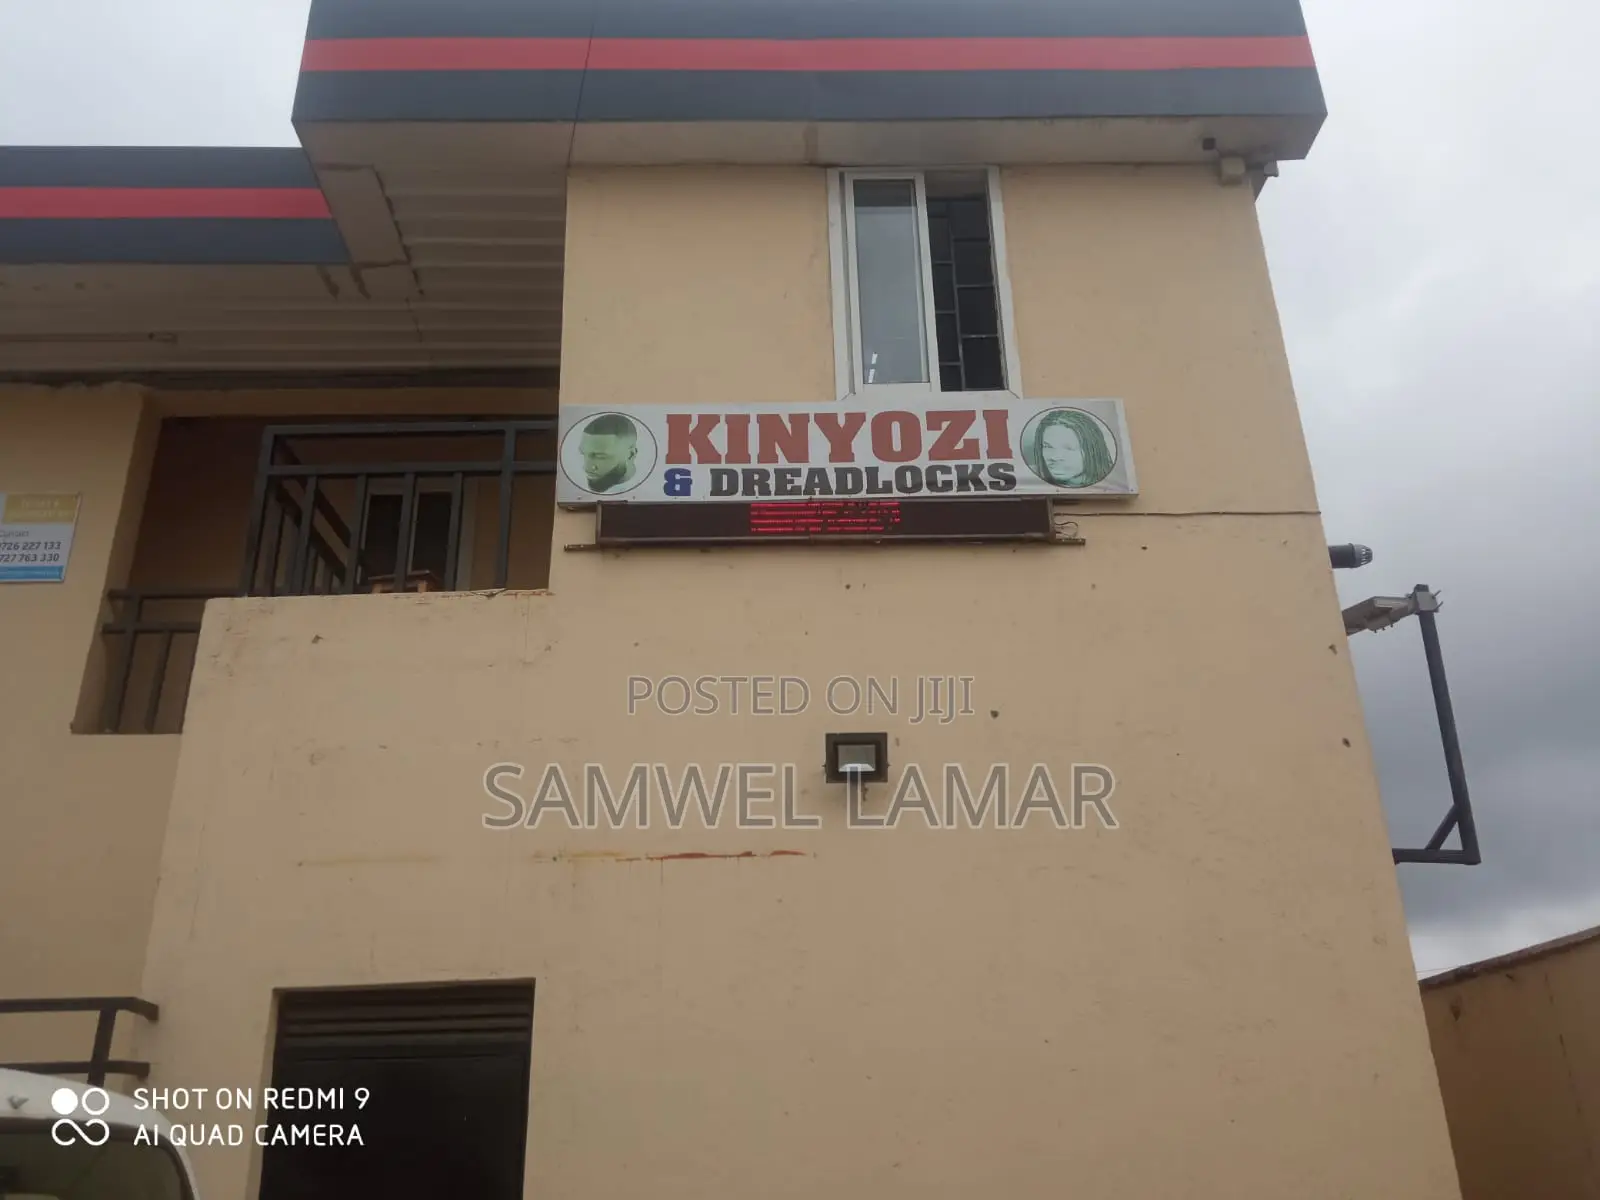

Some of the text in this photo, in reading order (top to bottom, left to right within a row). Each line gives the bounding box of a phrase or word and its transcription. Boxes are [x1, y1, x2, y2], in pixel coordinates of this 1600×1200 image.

[665, 409, 1014, 465] KINYOZI
[664, 462, 1017, 497] & DREADLOCKS
[0, 541, 61, 551] 726 227 133
[18, 553, 37, 563] 763
[39, 553, 60, 563] 330
